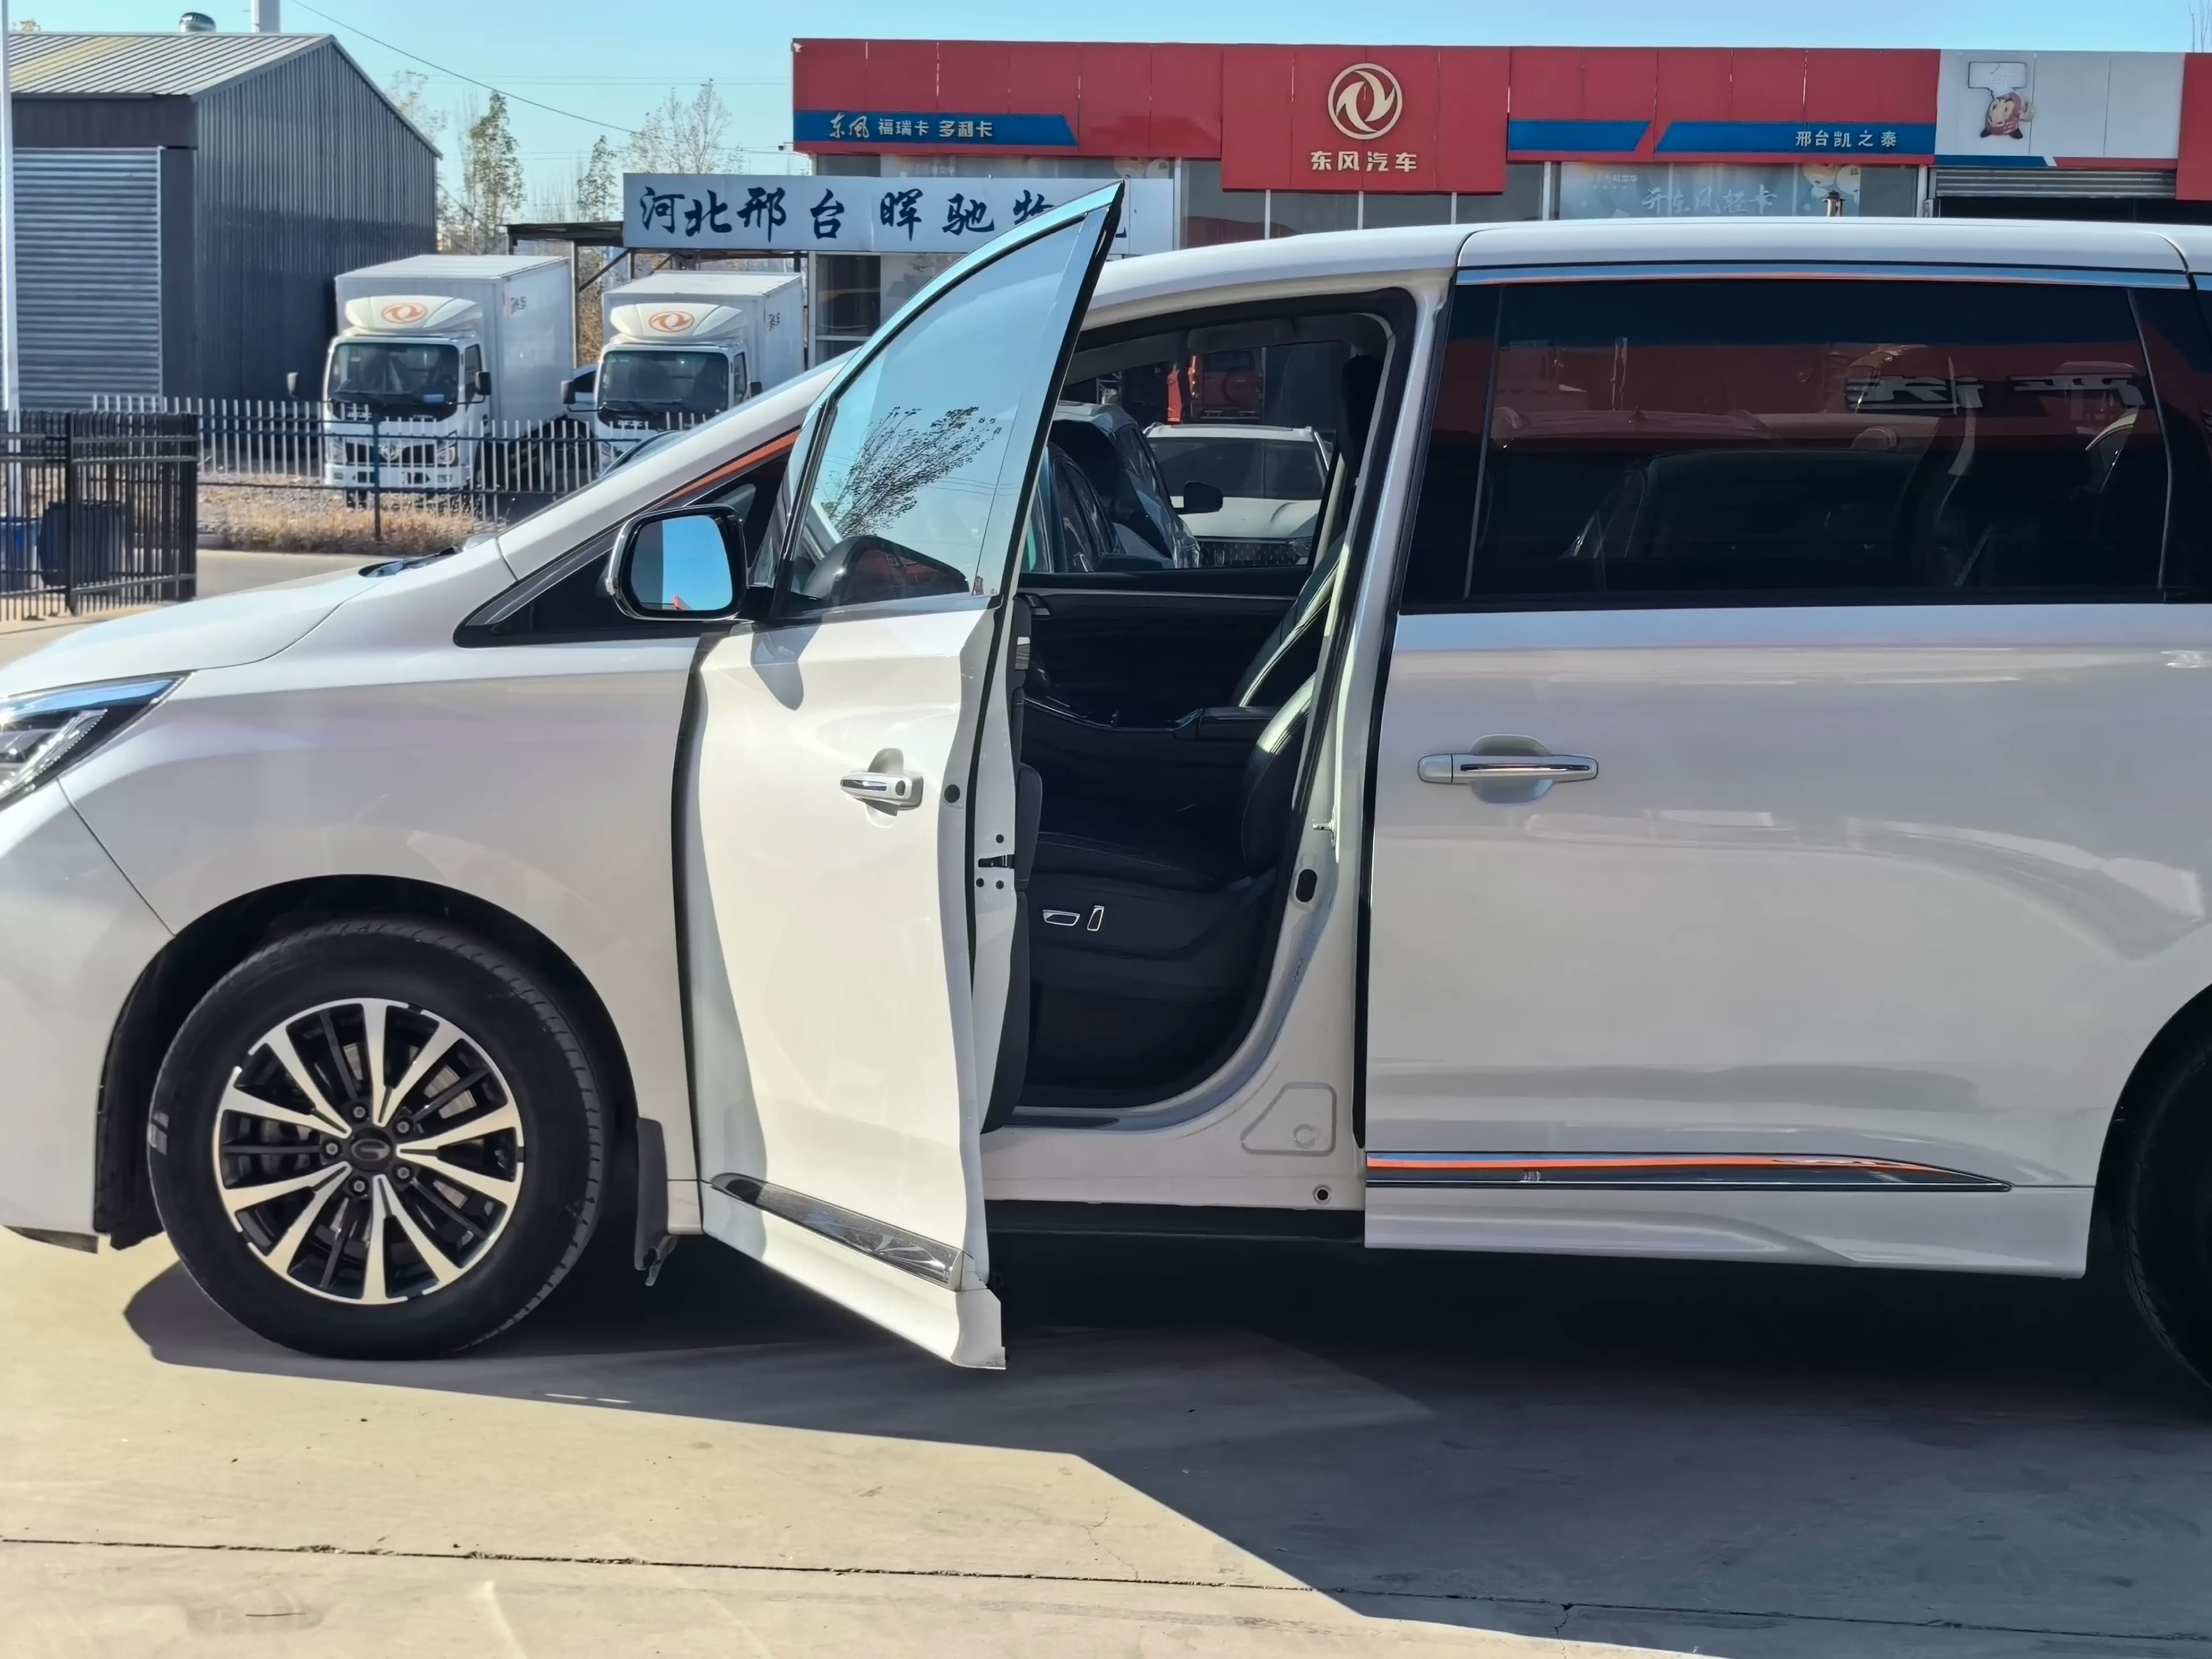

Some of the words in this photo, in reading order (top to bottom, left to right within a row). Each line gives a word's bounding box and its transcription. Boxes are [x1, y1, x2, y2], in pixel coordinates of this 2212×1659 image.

[830, 112, 869, 138] 东风
[878, 118, 929, 136] 福瑞卡
[939, 120, 993, 138] 多利卡
[1796, 130, 1897, 147] 邢台凯之泰
[1310, 150, 1417, 172] 东风汽车
